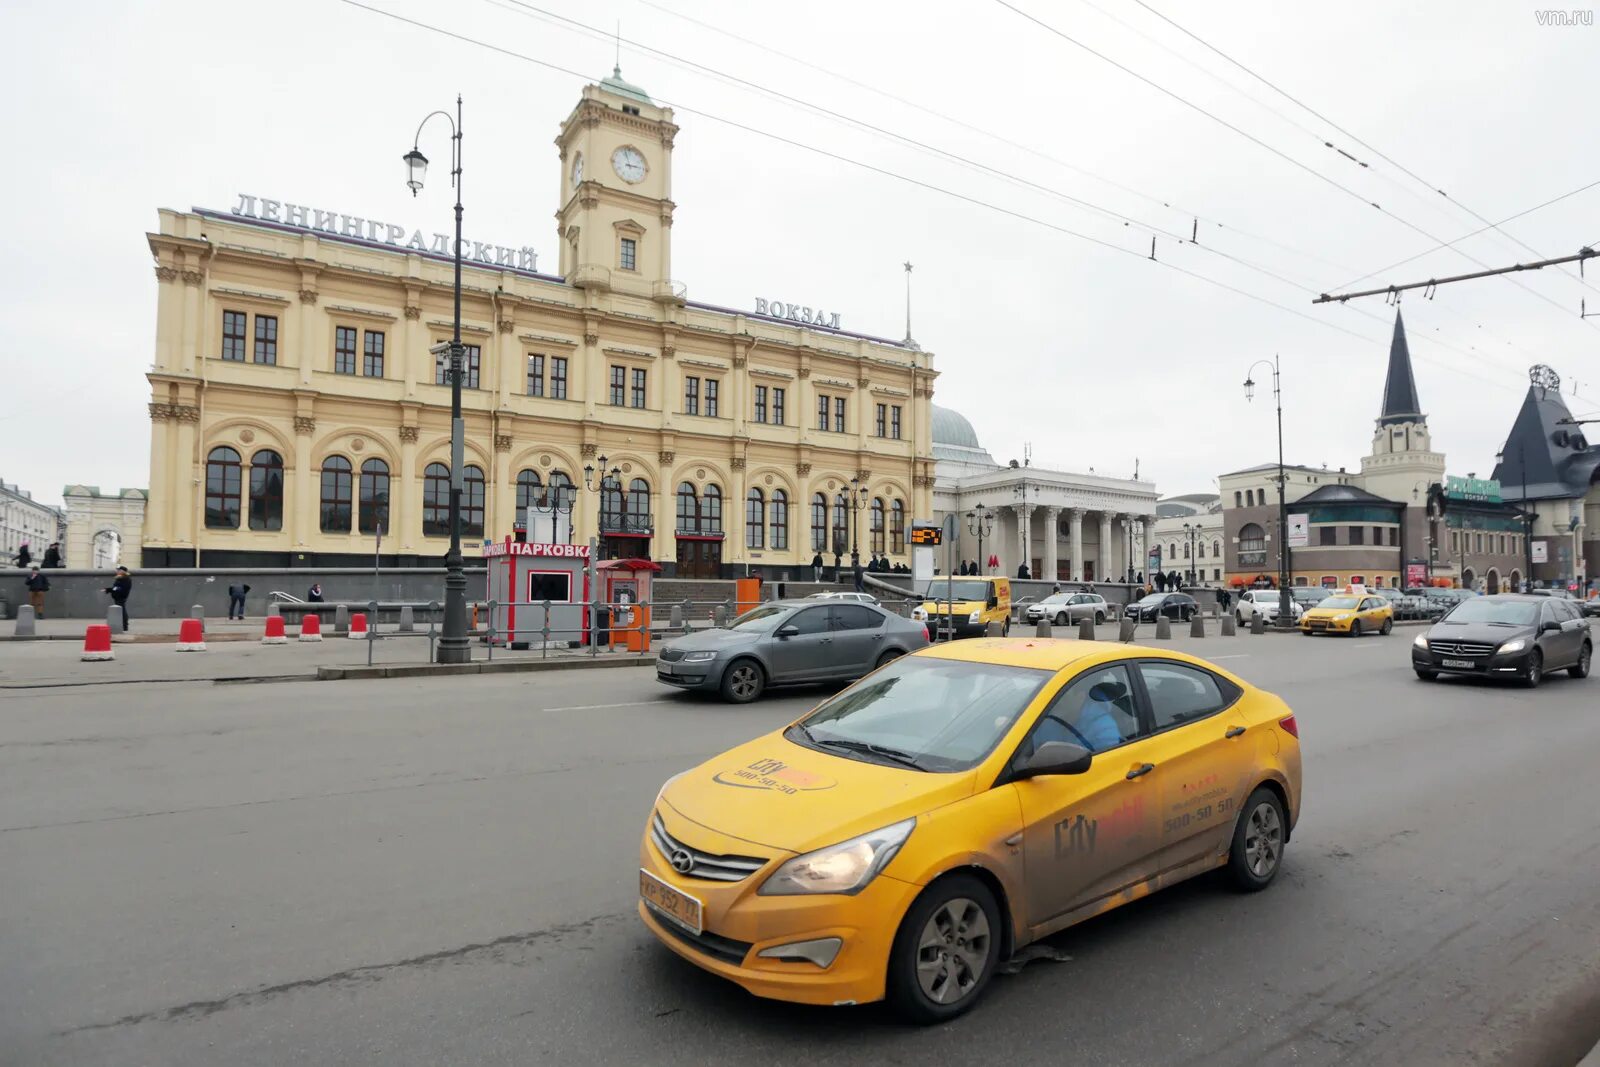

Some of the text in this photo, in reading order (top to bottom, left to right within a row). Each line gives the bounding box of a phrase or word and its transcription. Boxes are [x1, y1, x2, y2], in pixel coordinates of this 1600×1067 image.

[231, 193, 539, 273] ЛЕНИНГРАДСКИЙ
[755, 296, 841, 330] ВОКЗАЛ
[734, 769, 798, 795] 500-50-50
